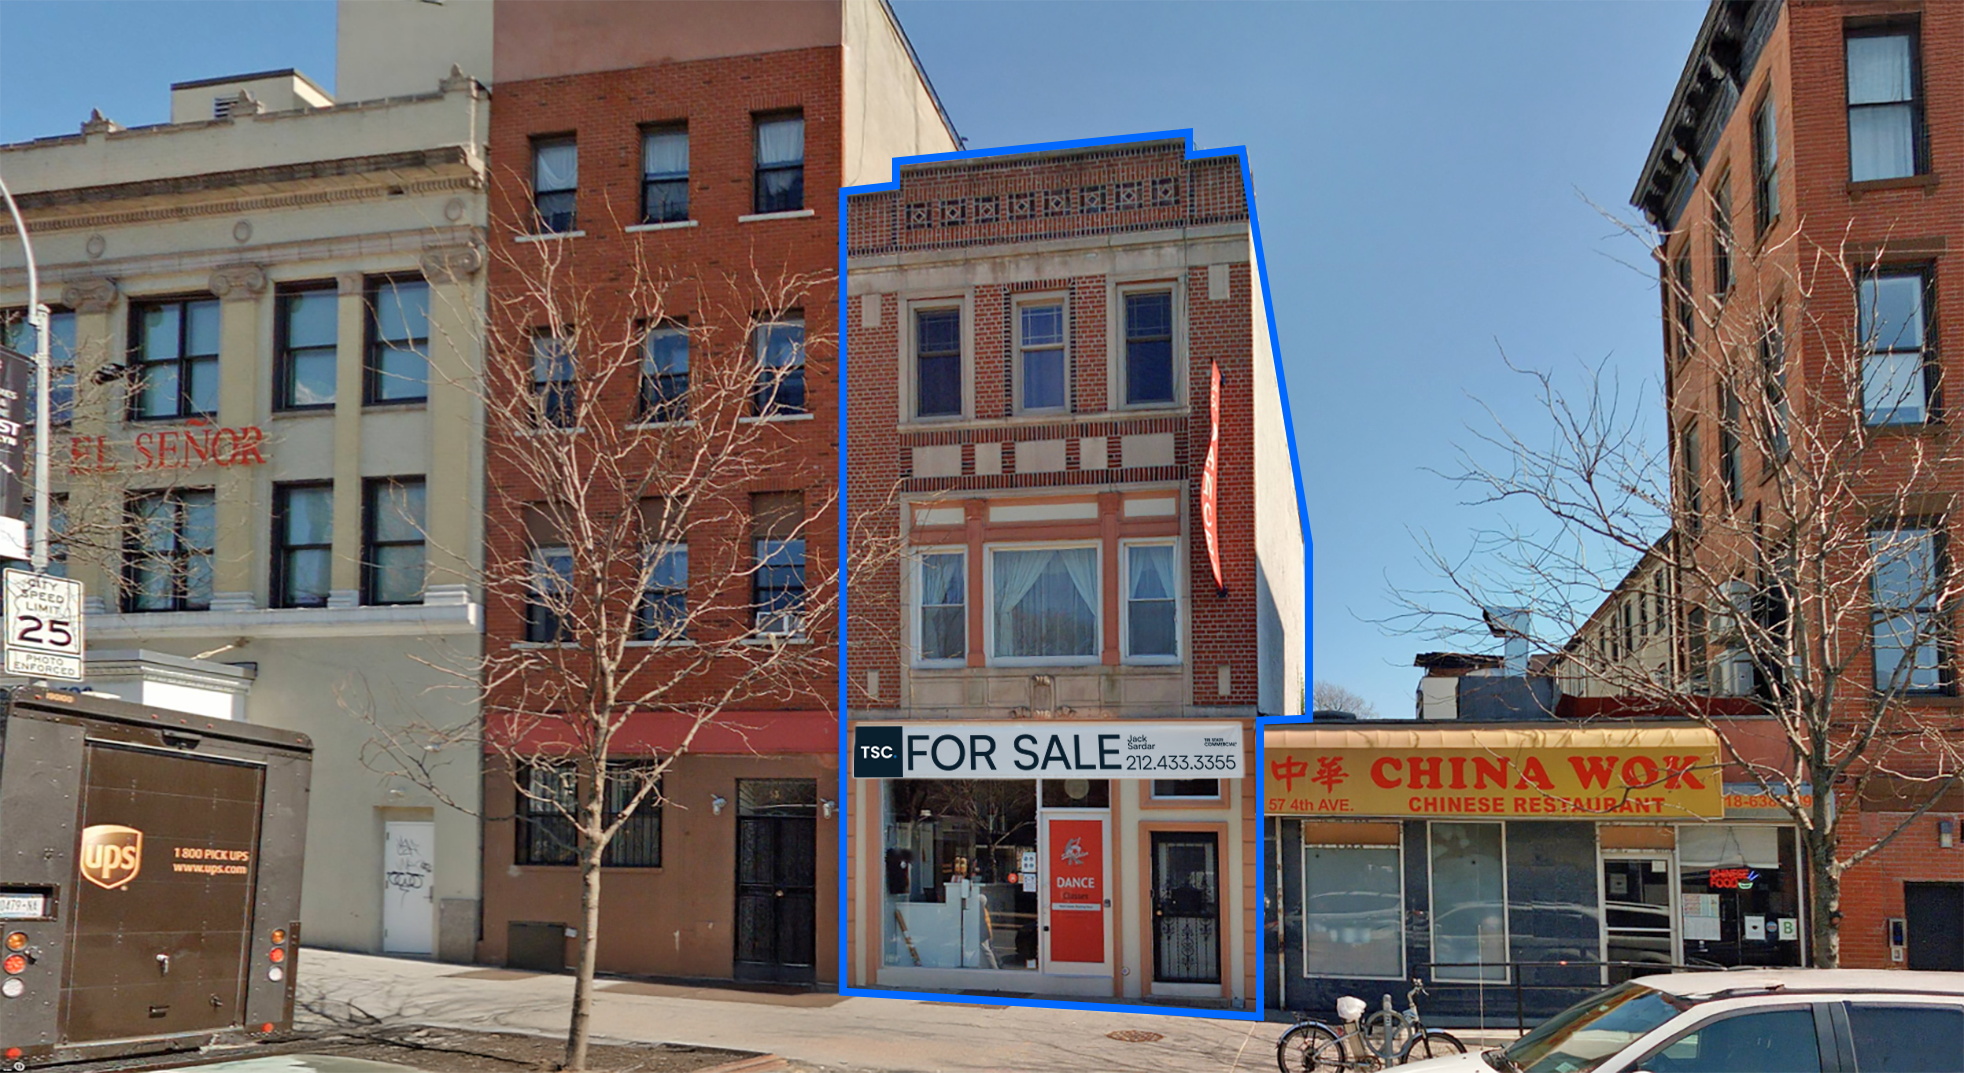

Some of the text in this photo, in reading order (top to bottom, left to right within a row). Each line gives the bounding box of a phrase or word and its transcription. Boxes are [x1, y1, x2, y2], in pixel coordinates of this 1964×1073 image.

[71, 436, 118, 475] EL
[136, 418, 266, 470] SEÑOR
[27, 579, 58, 591] CITY
[21, 590, 64, 603] SPEED
[26, 602, 61, 615] LIMIT
[17, 615, 72, 646] 25
[26, 654, 64, 667] PHOTO
[14, 662, 76, 676] ENFORCED
[1127, 734, 1147, 743] Jack
[907, 733, 1122, 771] FOR SALE
[1127, 742, 1156, 750] Sardar
[1126, 755, 1236, 770] 212.433.3355
[1271, 755, 1350, 794] 中華
[1370, 755, 1706, 790] CHINA WOK
[1268, 798, 1354, 811] 57 4th AVE.
[1408, 796, 1666, 813] CHINESE RESTAURANT
[174, 847, 250, 862] 1 800 PICK UPS
[85, 844, 137, 879] ups
[172, 863, 248, 876] www.ups.com
[1056, 877, 1095, 888] DANCE
[1709, 878, 1738, 888] FOOD
[1783, 921, 1793, 934] B
